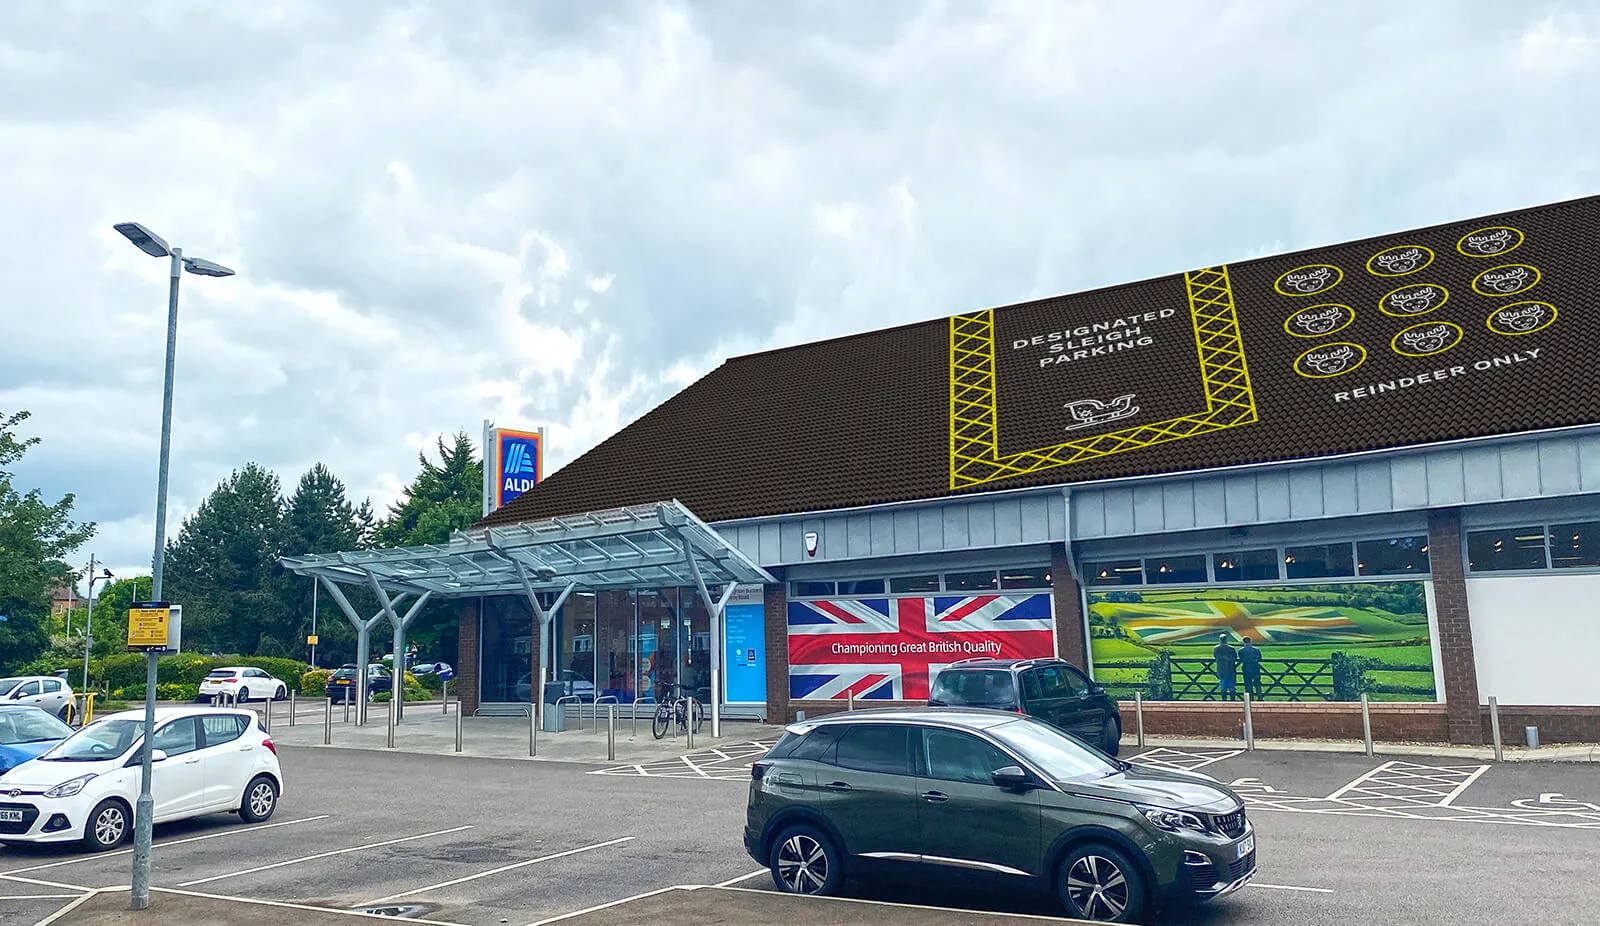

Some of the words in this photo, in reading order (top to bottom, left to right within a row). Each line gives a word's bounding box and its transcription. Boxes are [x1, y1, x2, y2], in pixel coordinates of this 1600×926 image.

[1013, 308, 1175, 350] DESIGNATED
[1049, 326, 1141, 354] SLEIGH
[1040, 336, 1154, 368] PARKING
[1334, 366, 1466, 403] REINDEER
[1473, 348, 1541, 371] ONLY
[504, 477, 535, 493] ALDI
[831, 642, 898, 656] Championing
[899, 641, 927, 654] Great
[928, 640, 962, 654] British
[963, 640, 1002, 655] Quality
